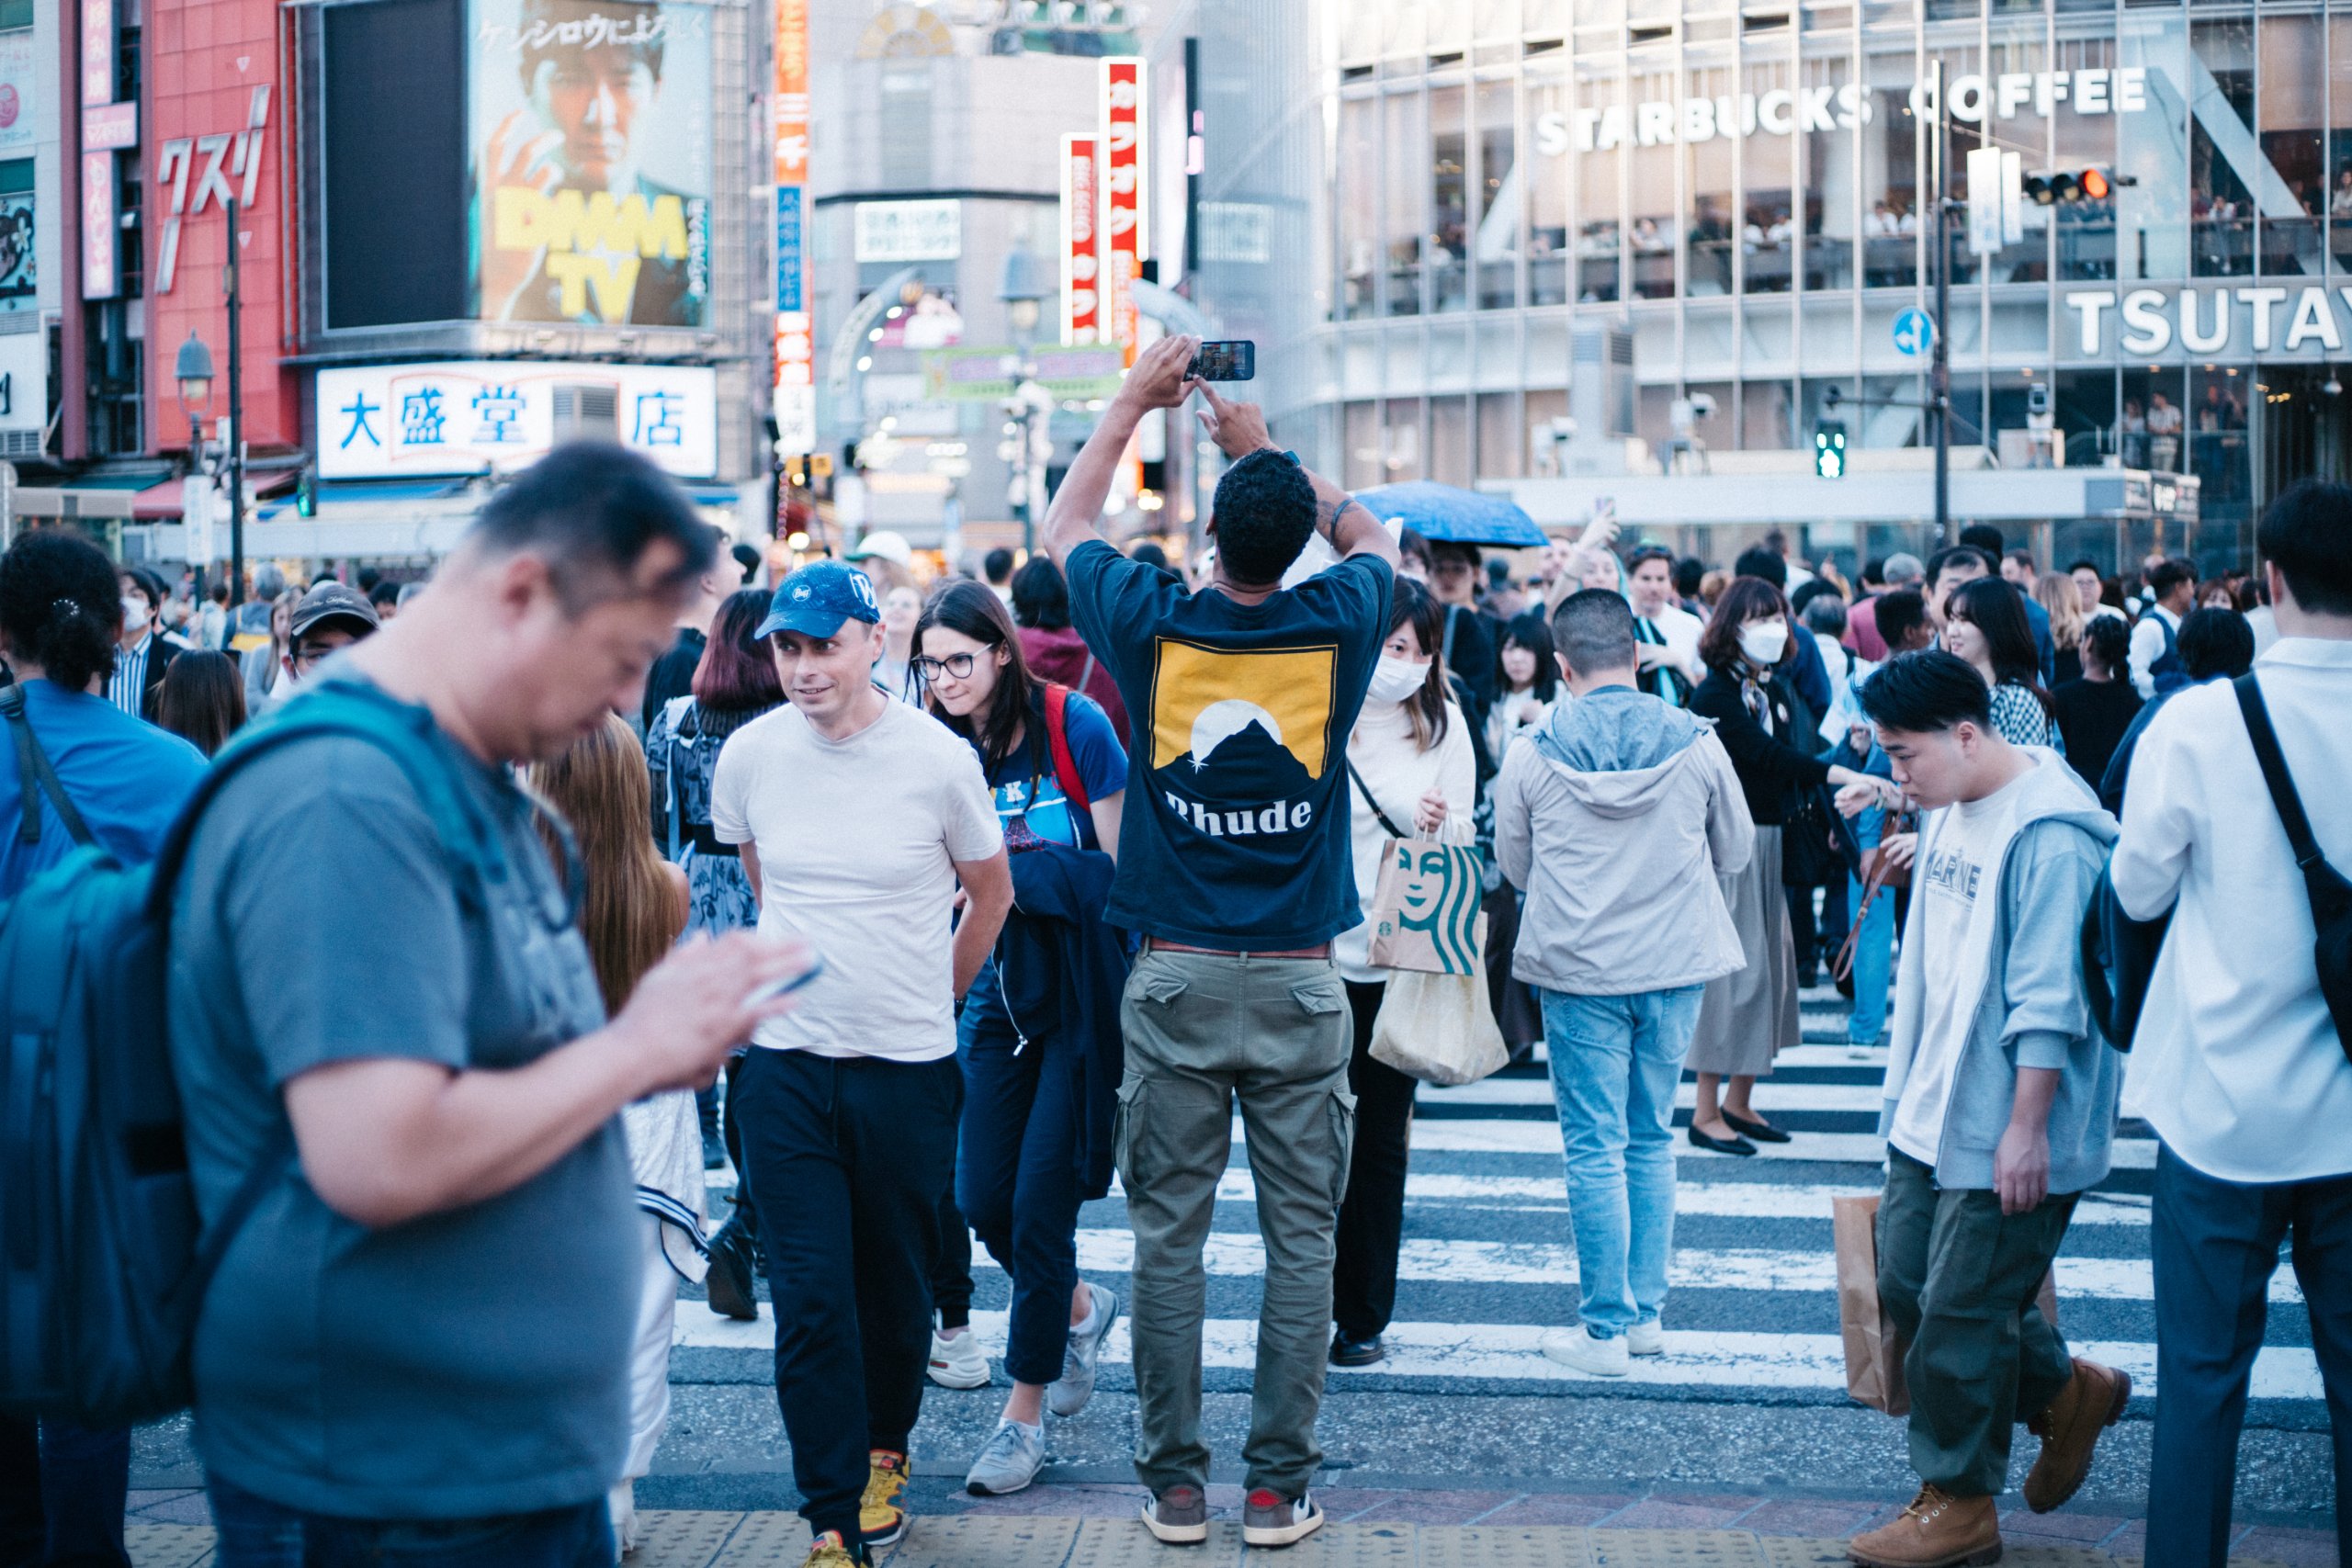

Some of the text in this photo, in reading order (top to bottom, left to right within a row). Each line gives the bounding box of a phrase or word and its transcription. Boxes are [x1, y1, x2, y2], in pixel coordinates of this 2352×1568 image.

[1536, 67, 2146, 156] STARBUCKS COFFEE
[153, 83, 271, 294] クスリ
[494, 186, 688, 260] DMM
[546, 250, 642, 322] TV
[2066, 286, 2352, 355] TSUTA
[340, 383, 685, 450] 大盛堂店
[1165, 790, 1312, 837] Rhude
